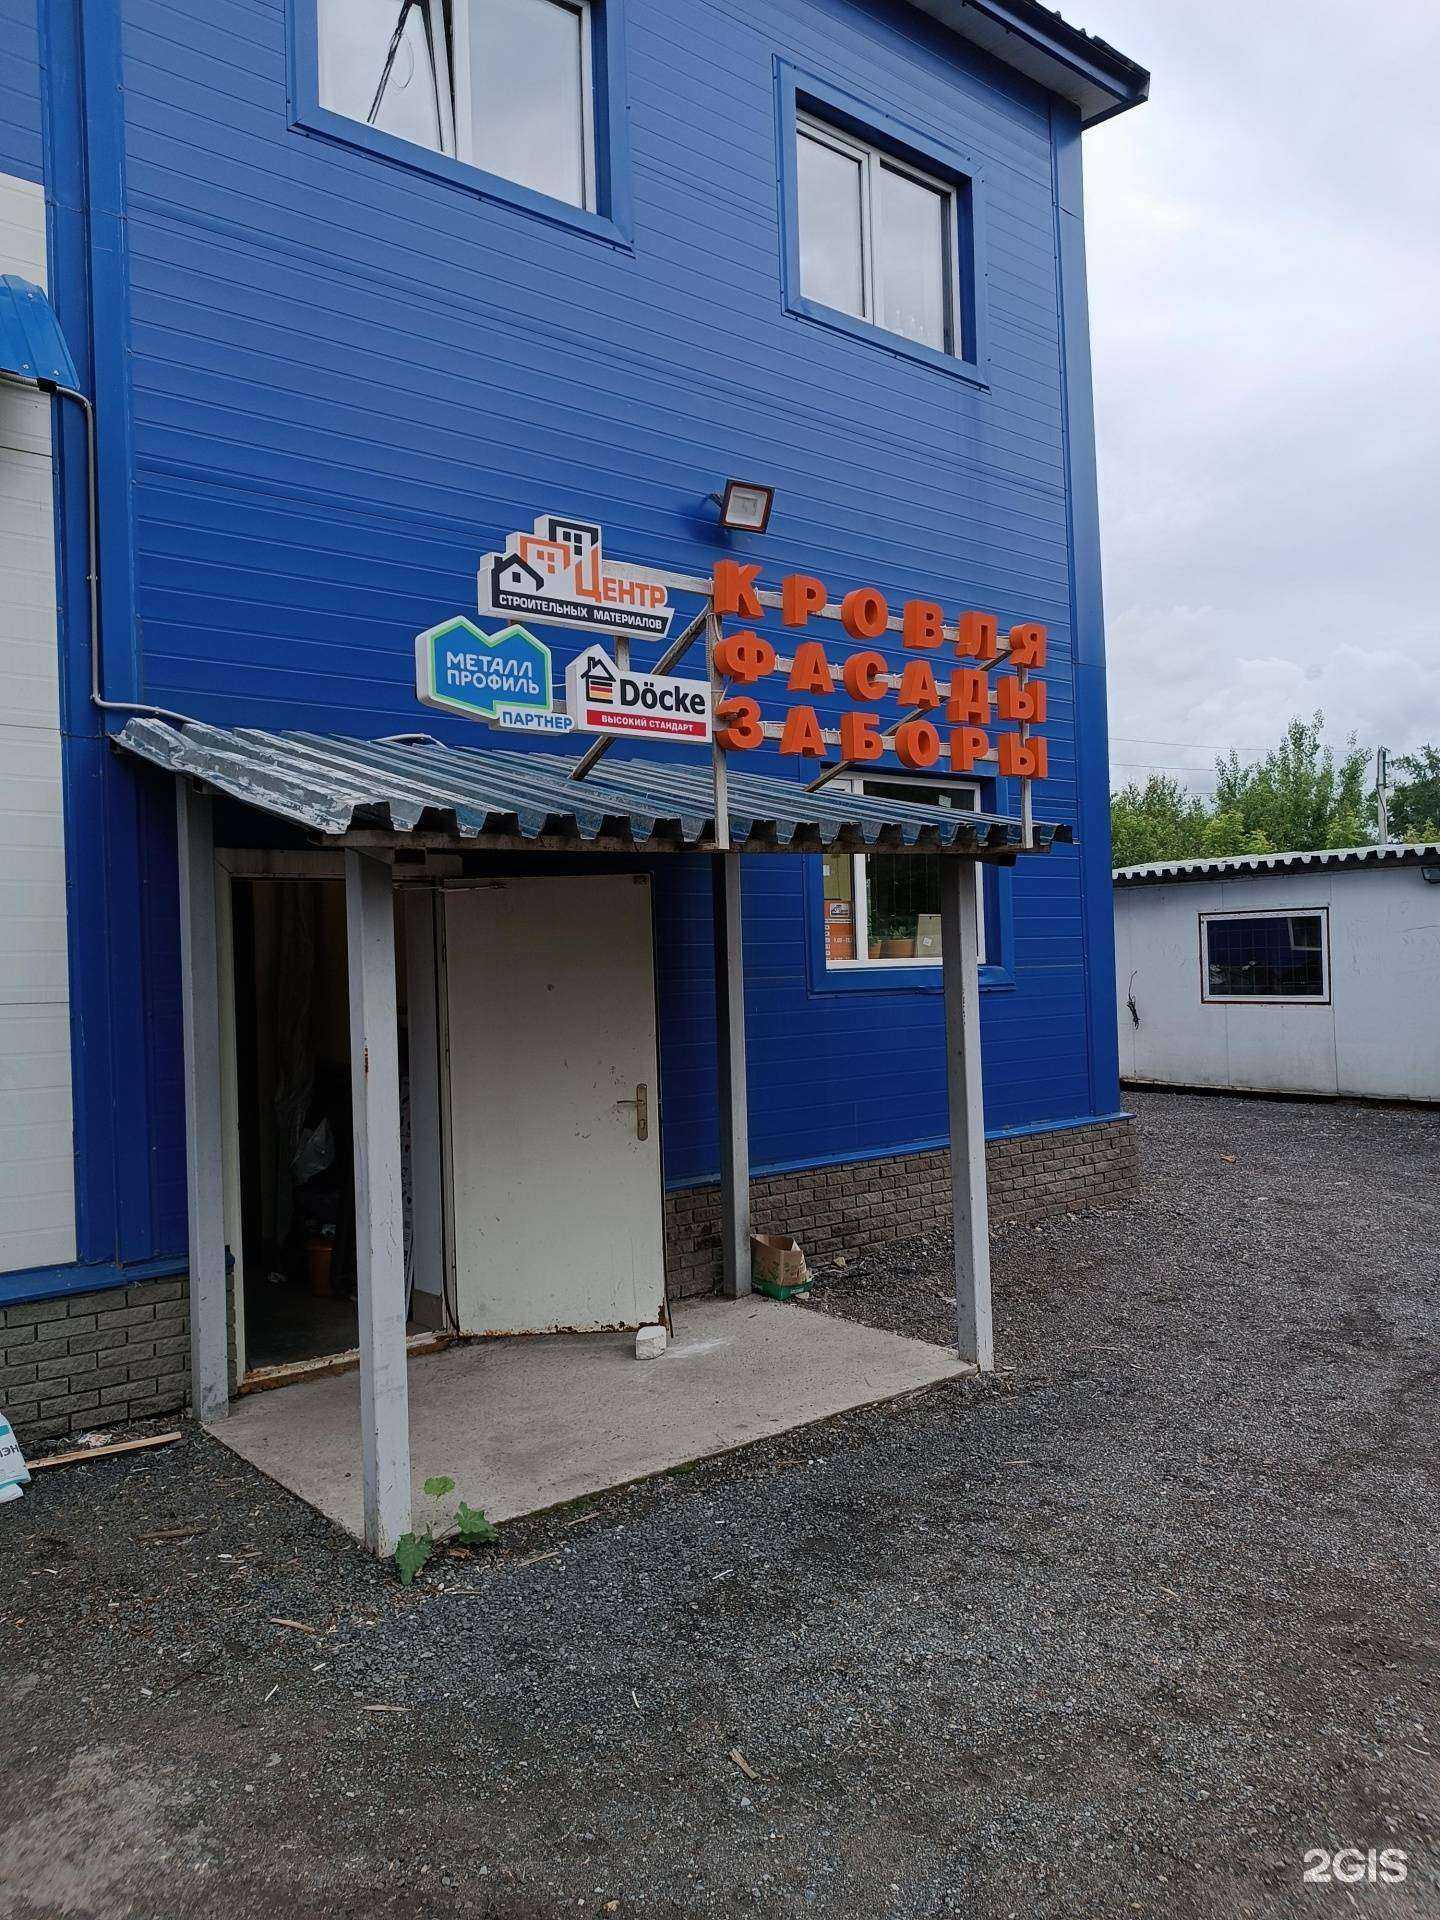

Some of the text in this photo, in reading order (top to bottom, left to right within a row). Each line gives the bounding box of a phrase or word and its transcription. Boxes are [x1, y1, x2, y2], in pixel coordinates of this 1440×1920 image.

[575, 546, 666, 608] ЦЕНТР
[499, 594, 662, 630] СТРОИТЕЛЬНЫХ МАТЕРИАЛОВ
[713, 559, 1047, 668] КРОВЛЯ
[446, 651, 532, 678] МЕТАЛЛ
[447, 669, 540, 694] ПРОФИЛЬ
[714, 630, 1047, 726] ФАСАДЫ
[620, 678, 706, 715] Döcke
[502, 711, 573, 730] ПАРТНЕР
[601, 714, 693, 732] ВЫСОКИЙ СТАНДАРТ
[714, 697, 1048, 779] ЗАБОРЫ
